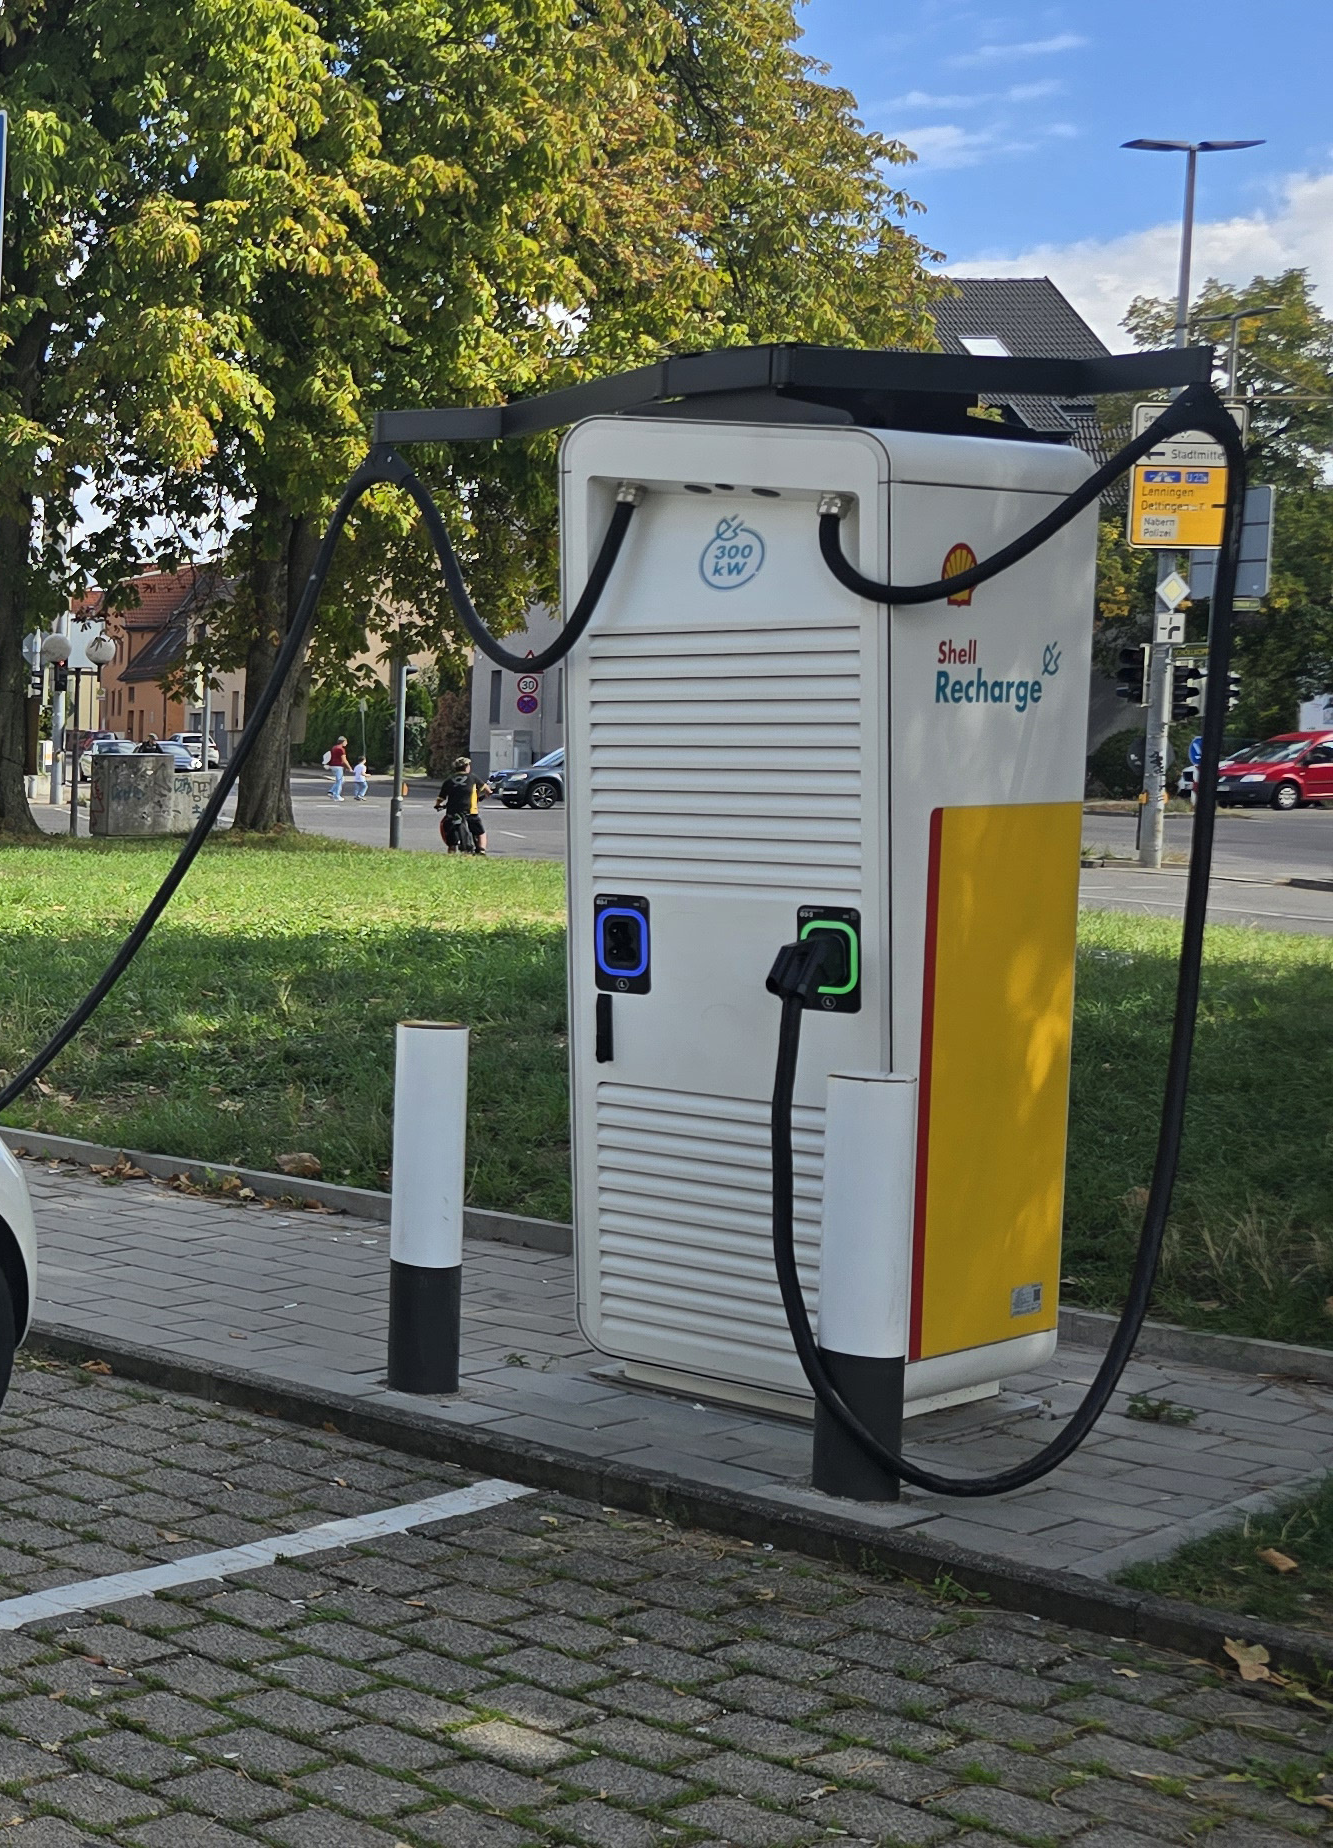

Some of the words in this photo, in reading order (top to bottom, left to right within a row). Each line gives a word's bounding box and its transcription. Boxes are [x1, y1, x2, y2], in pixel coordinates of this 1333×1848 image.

[1171, 449, 1223, 460] Stadtmitte
[1141, 486, 1194, 499] Lenningen
[1144, 529, 1171, 537] Polizei
[714, 544, 753, 560] 300
[712, 561, 747, 576] kW
[937, 639, 977, 665] Shell
[521, 680, 535, 690] 30
[935, 667, 1042, 713] Recharge
